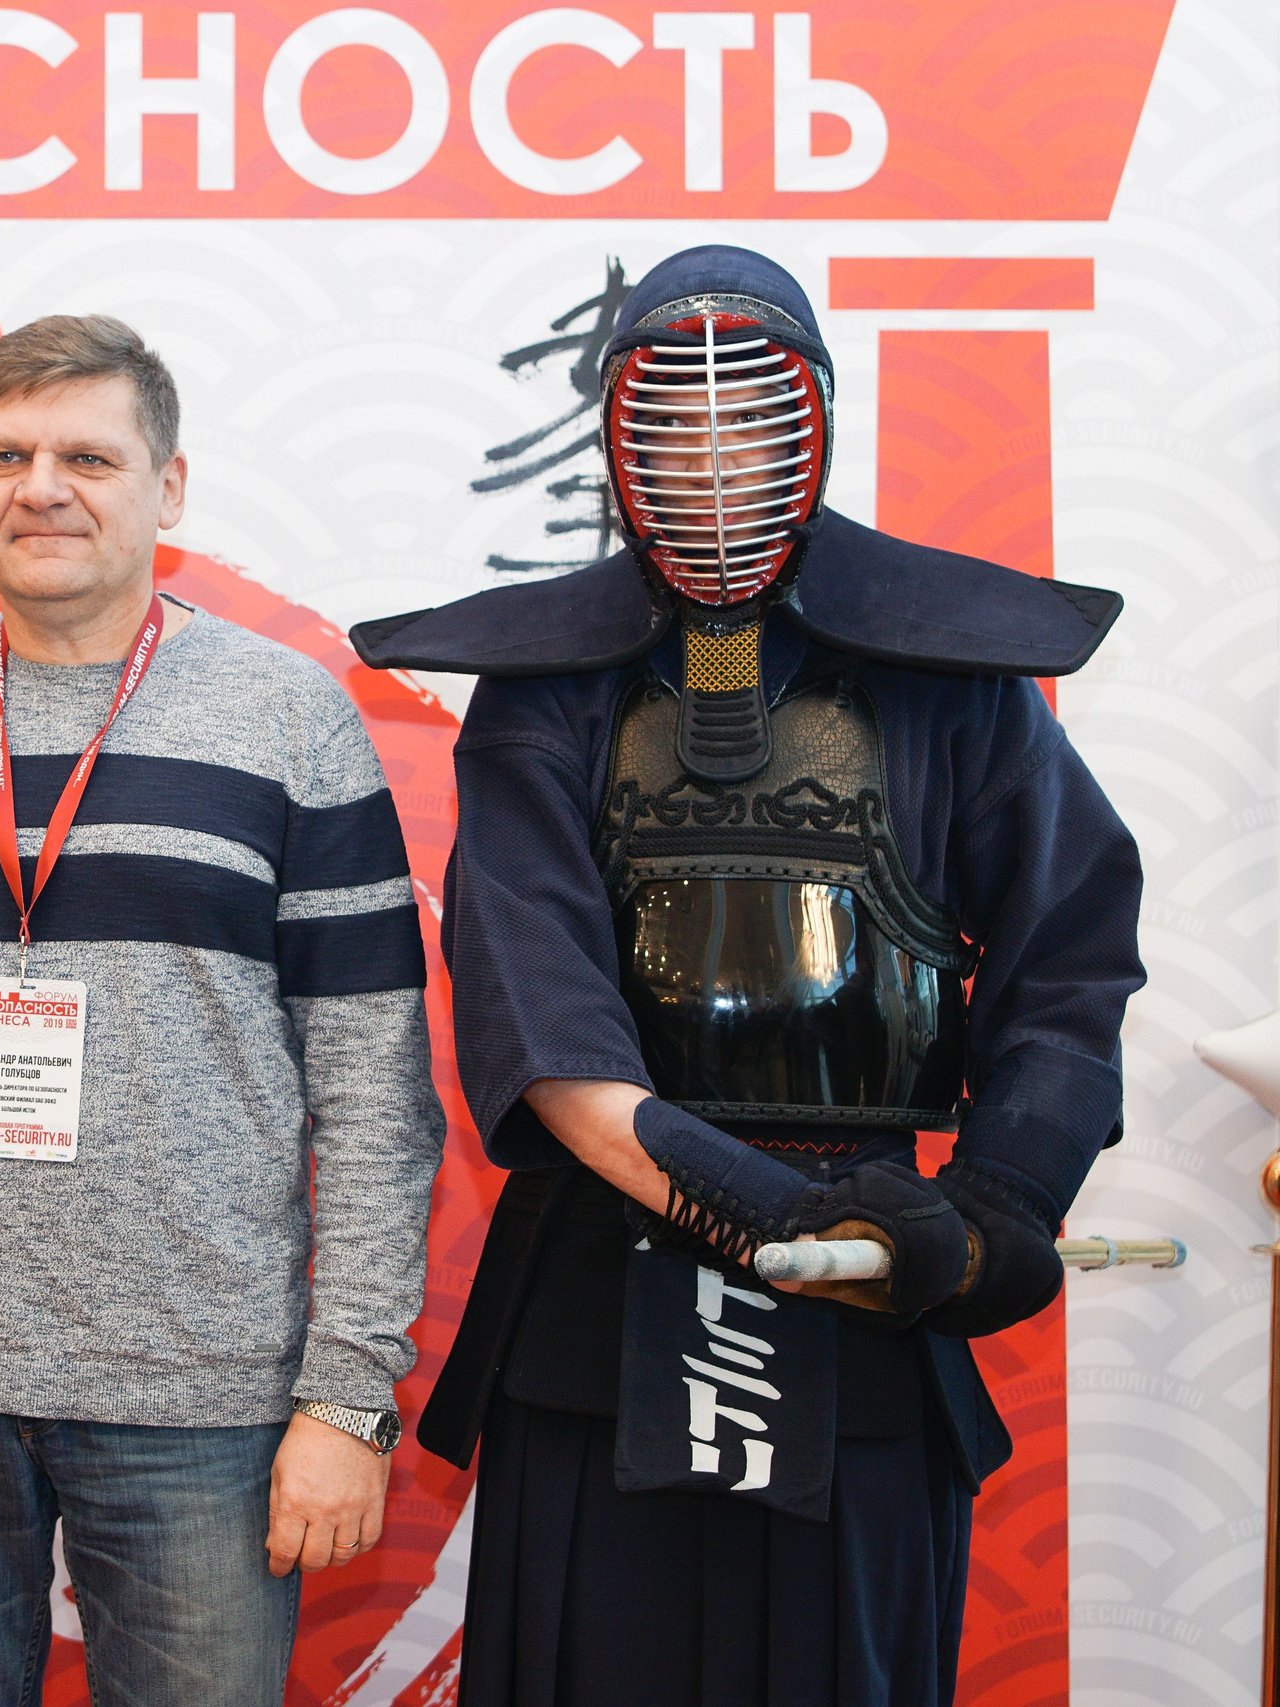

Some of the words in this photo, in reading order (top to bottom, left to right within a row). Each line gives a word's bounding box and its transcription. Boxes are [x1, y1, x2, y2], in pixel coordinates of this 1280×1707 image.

[34, 991, 78, 1002] ФОРУМ
[43, 1017, 63, 1029] 2019
[17, 1055, 73, 1067] АНАТОЛЬЕВИЧ
[0, 1067, 41, 1080] ГОЛУБЦОВ
